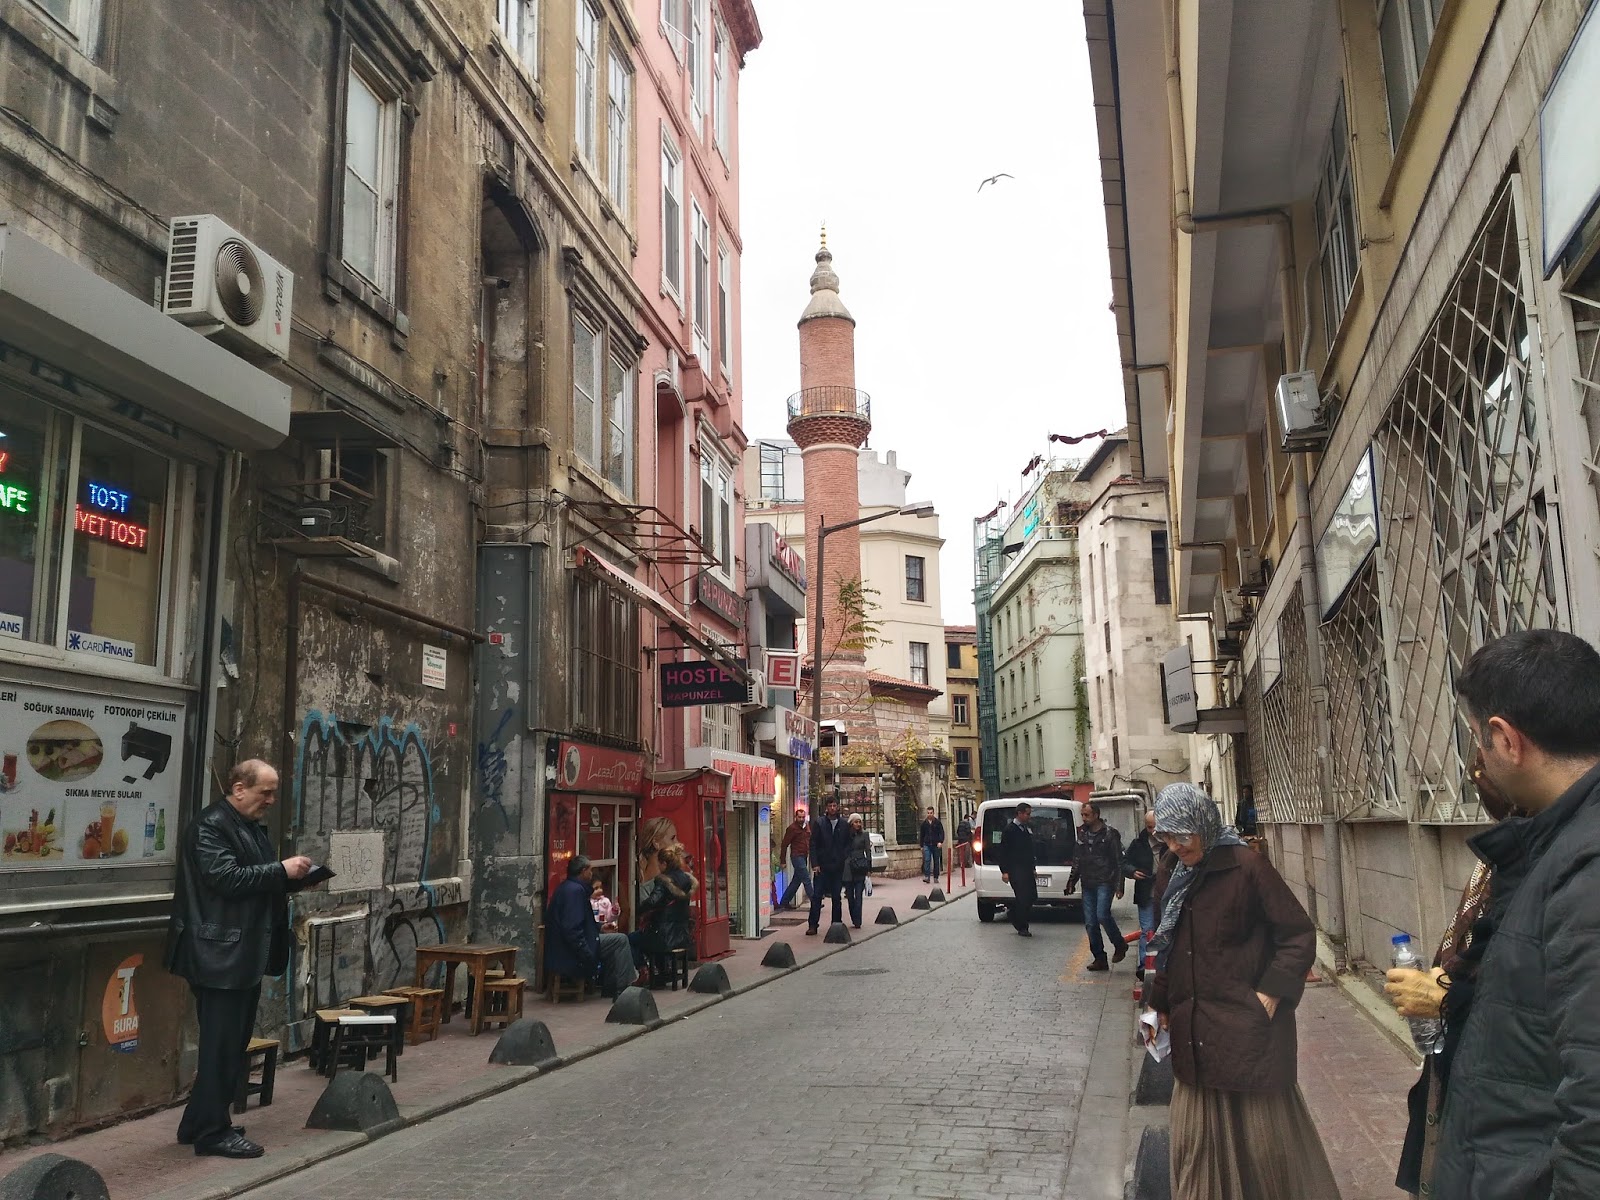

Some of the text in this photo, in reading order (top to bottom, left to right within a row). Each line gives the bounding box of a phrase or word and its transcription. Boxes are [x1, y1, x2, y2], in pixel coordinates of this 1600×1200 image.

[275, 270, 285, 321] arçelik
[89, 483, 128, 513] TOST
[109, 520, 146, 548] TOST
[666, 667, 737, 686] HOSTE
[773, 660, 791, 682] E
[666, 689, 724, 701] RAPUNZEL
[23, 702, 95, 720] SOĞUK SANDAVİÇ
[104, 705, 177, 722] FOTOKOPİ ÇEKİLİR
[65, 788, 142, 799] SIKMA MEYVE SULARI
[553, 839, 565, 849] TOST
